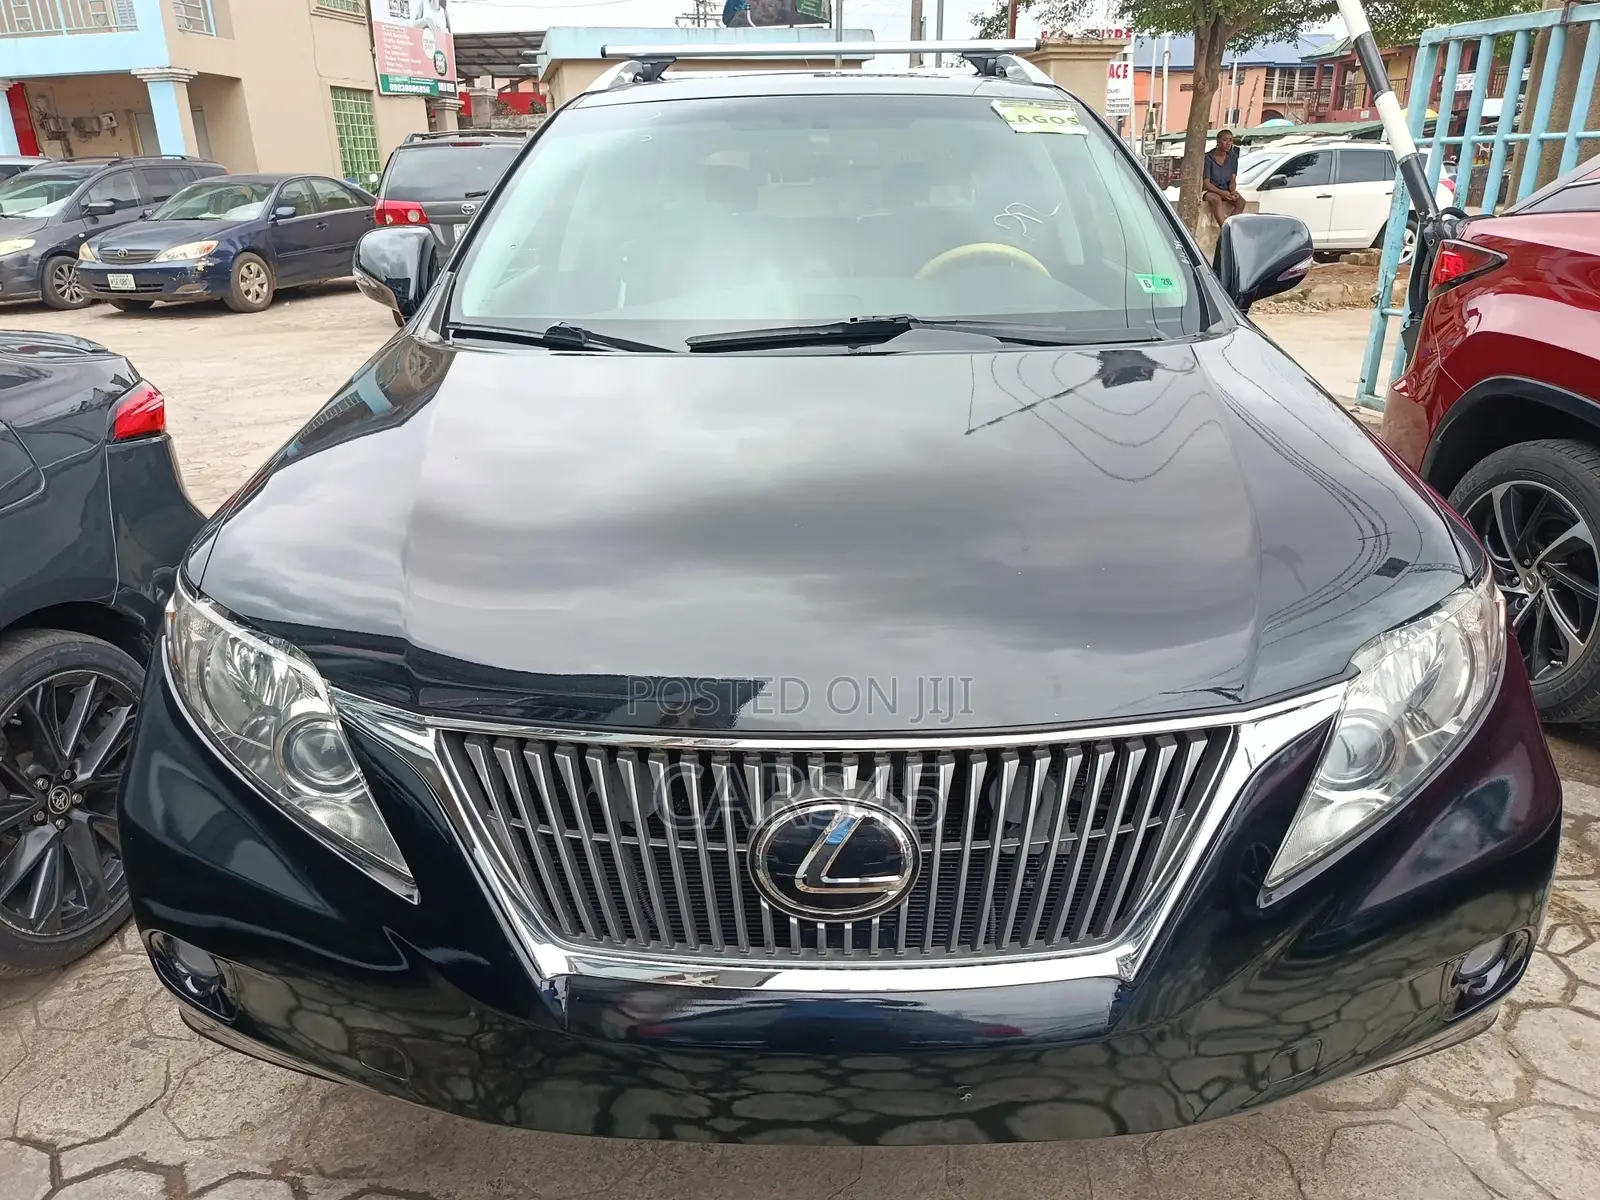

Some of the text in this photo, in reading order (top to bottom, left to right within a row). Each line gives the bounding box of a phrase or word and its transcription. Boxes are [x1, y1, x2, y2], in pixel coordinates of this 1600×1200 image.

[1108, 63, 1129, 79] ACE
[1002, 114, 1080, 126] LAGOS
[1143, 280, 1152, 289] 6
